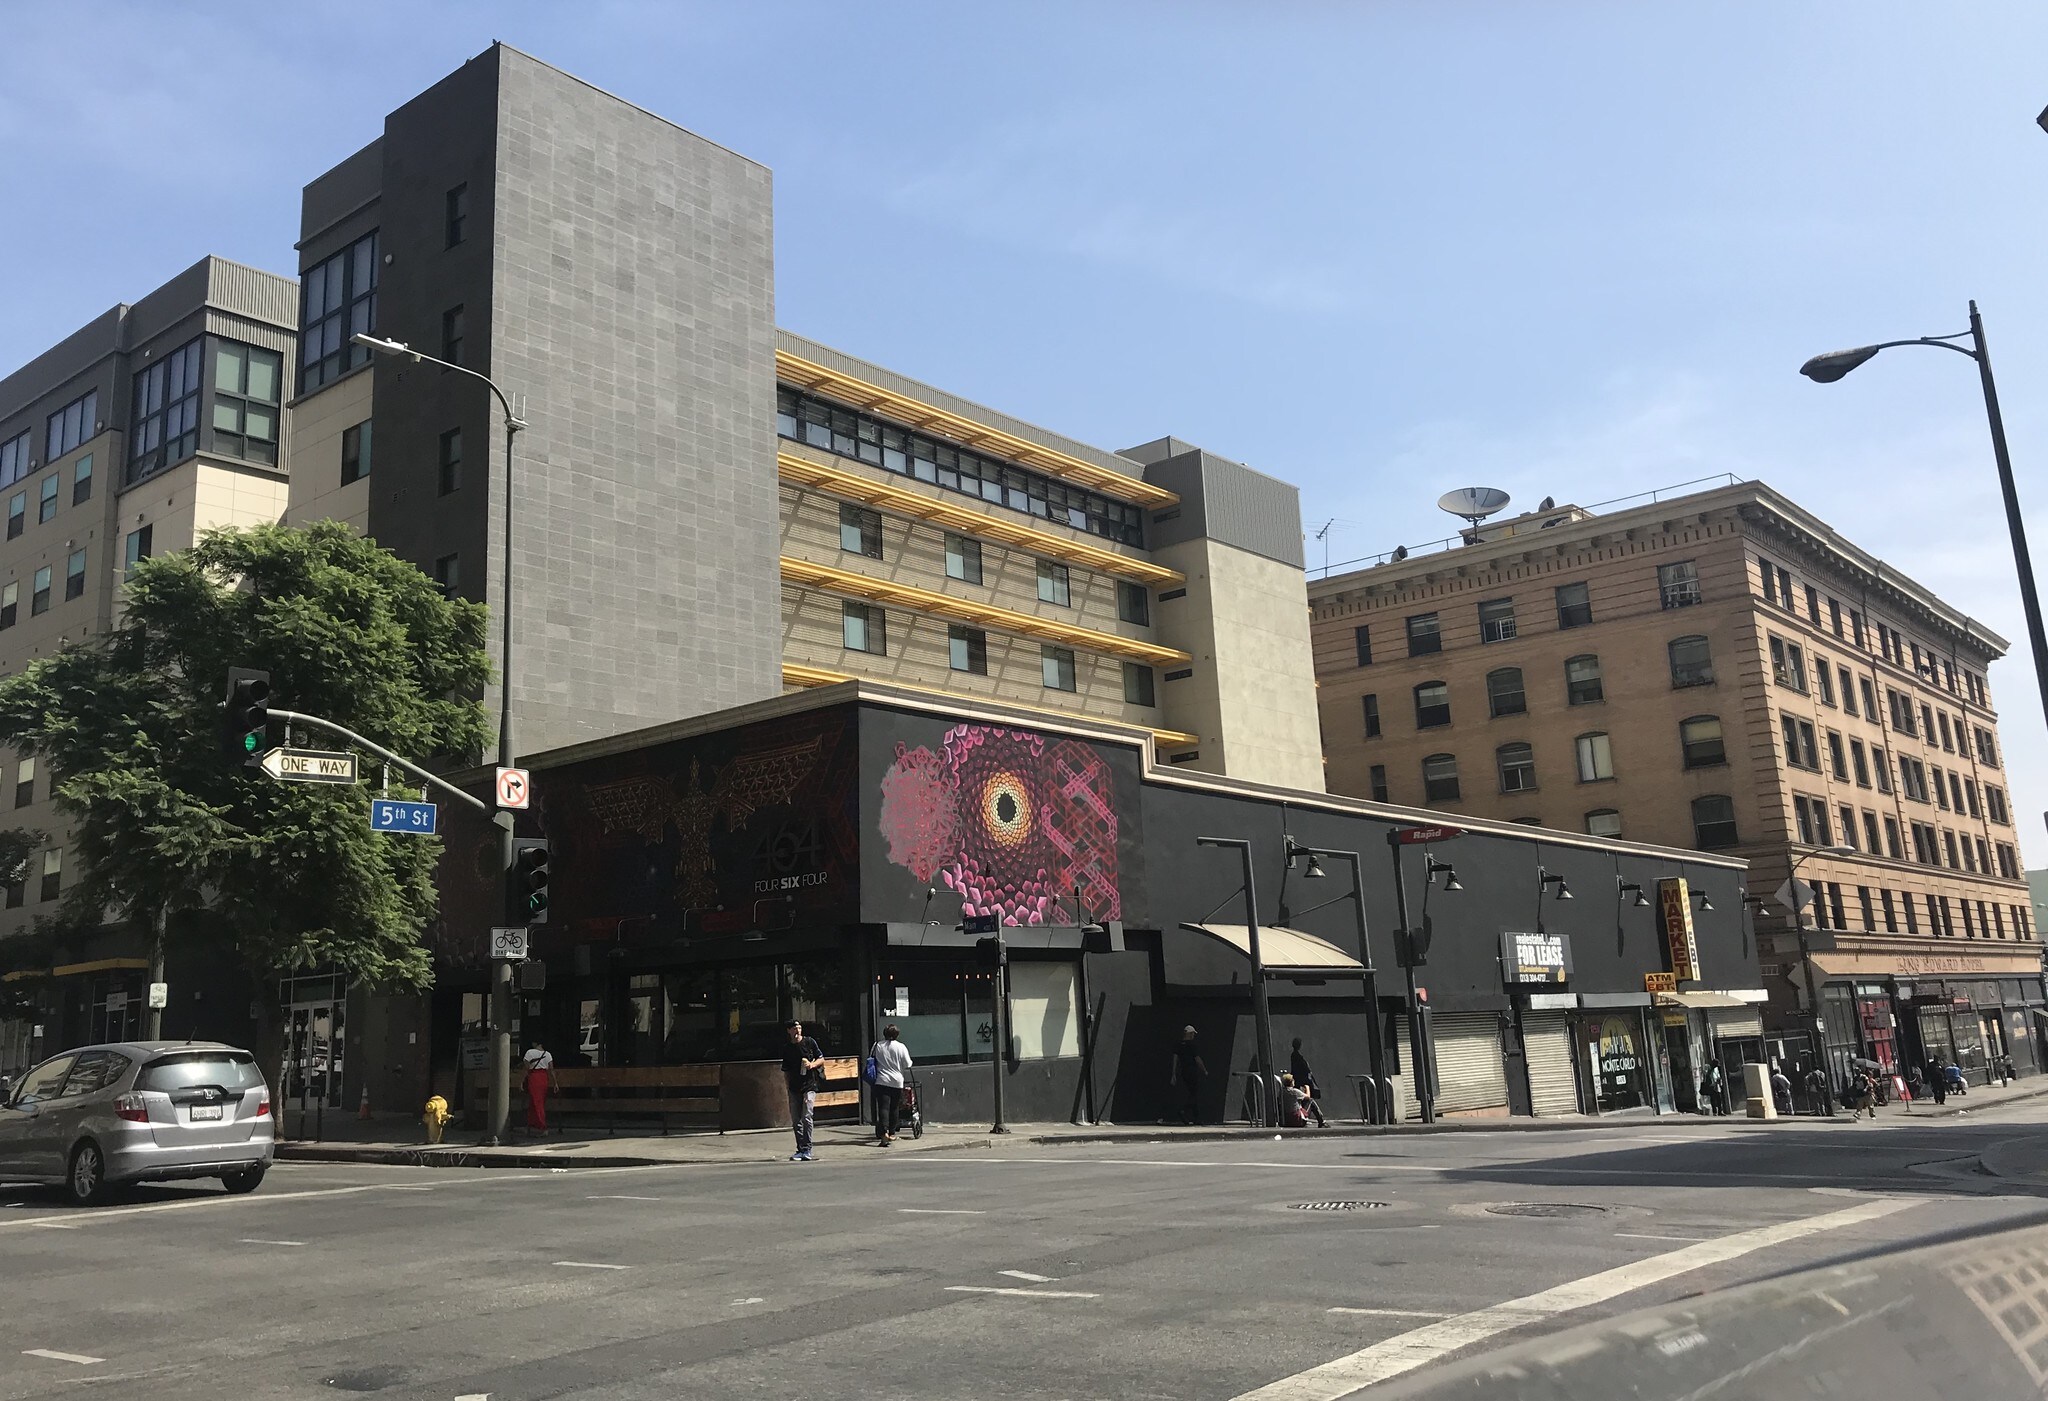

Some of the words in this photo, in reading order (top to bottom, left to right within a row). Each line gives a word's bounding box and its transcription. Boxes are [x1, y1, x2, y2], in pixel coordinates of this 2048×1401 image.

[281, 757, 309, 772] ONE
[319, 760, 348, 774] WAY
[381, 806, 406, 826] 5th
[412, 810, 429, 826] St
[1413, 829, 1442, 839] Rapid
[755, 879, 779, 892] FOUR
[781, 876, 800, 889] SIX
[803, 872, 828, 886] FOUR
[1663, 889, 1688, 977] MARKET
[1517, 945, 1537, 966] FOR
[1536, 946, 1564, 966] LEASE
[1648, 974, 1671, 982] ATM
[1602, 1058, 1620, 1073] MONTE
[1620, 1057, 1635, 1071] CARLO
